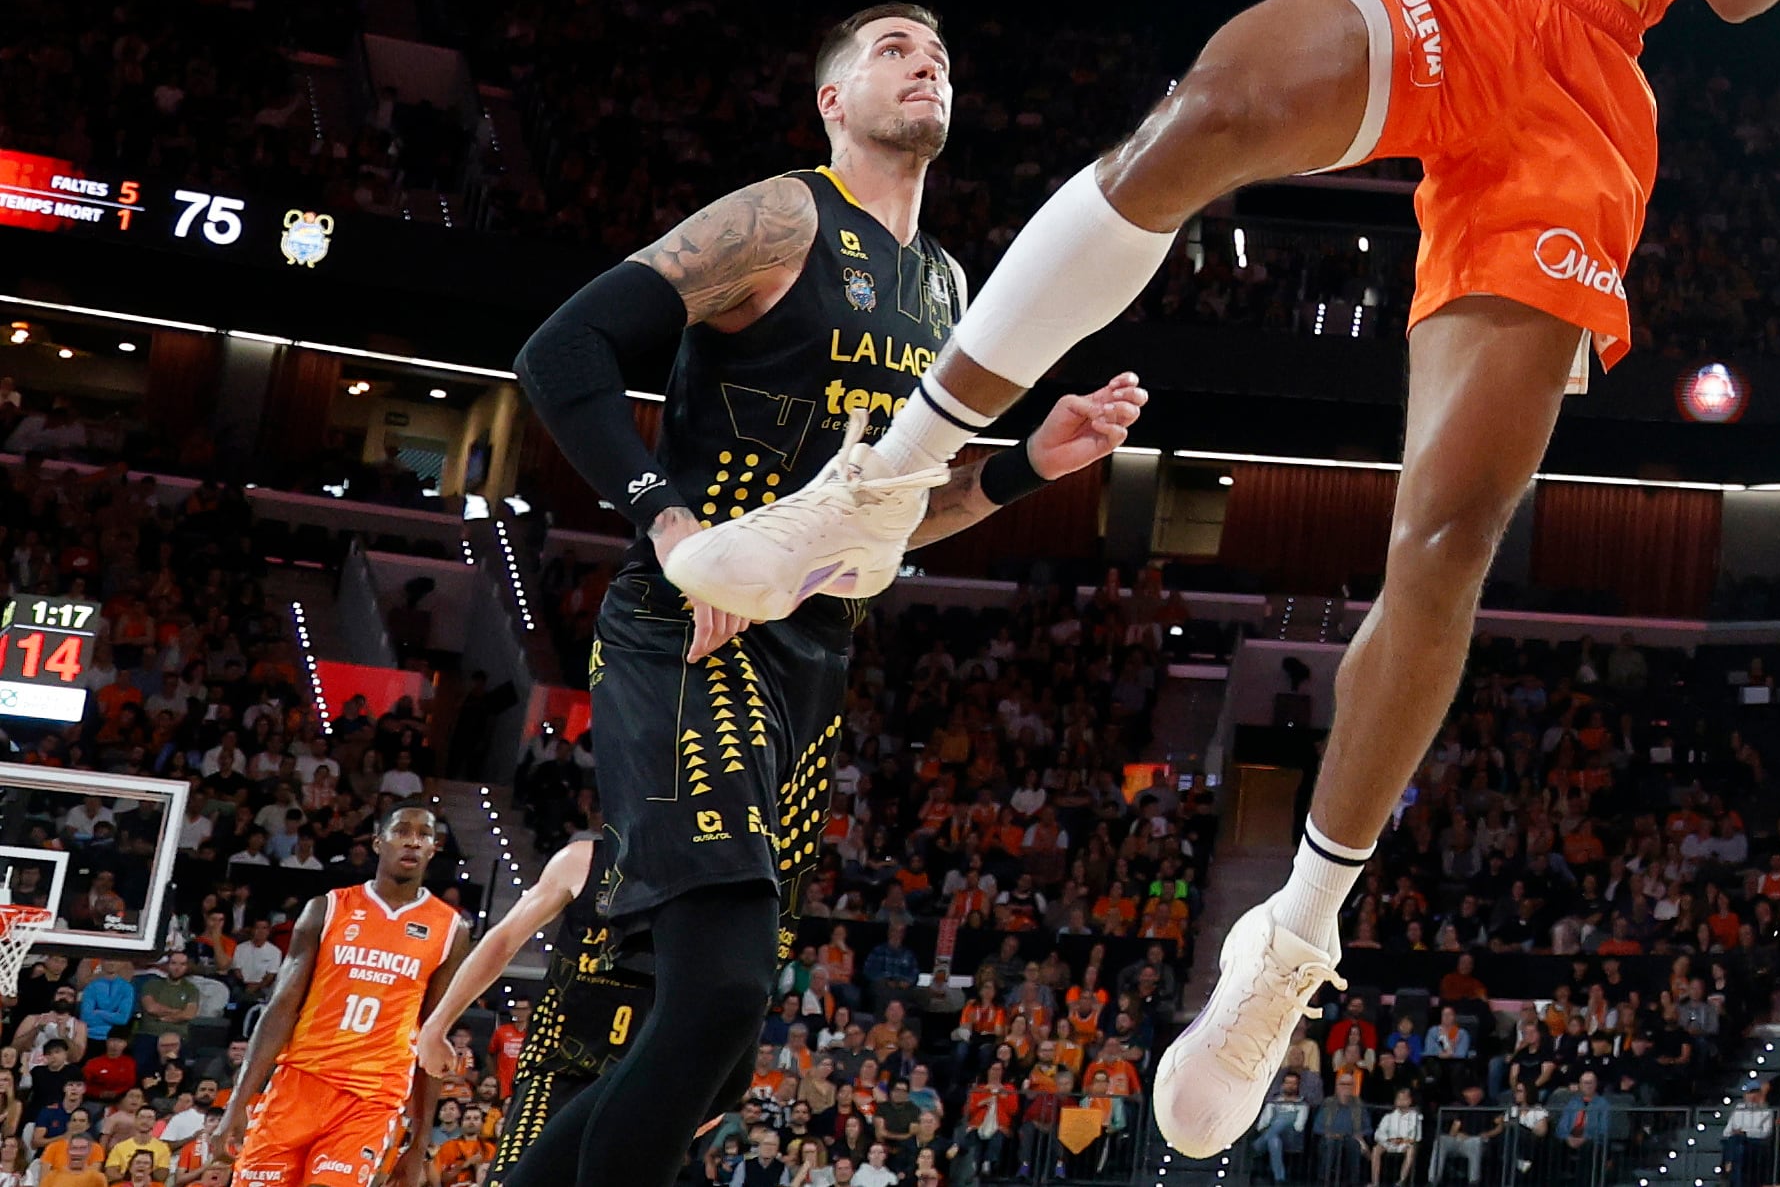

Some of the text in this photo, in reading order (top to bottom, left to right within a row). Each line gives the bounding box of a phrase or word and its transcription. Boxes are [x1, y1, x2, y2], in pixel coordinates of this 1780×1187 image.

[51, 175, 140, 204] FALTES 5
[0, 192, 132, 231] TEMPS MORT 1
[174, 189, 246, 246] 75
[830, 329, 938, 378] LA LAG
[32, 600, 94, 629] 1:17
[17, 631, 83, 682] 14
[334, 944, 421, 981] VALENCIA
[348, 967, 397, 986] BASKET
[340, 994, 380, 1033] 10
[609, 1005, 633, 1045] 9
